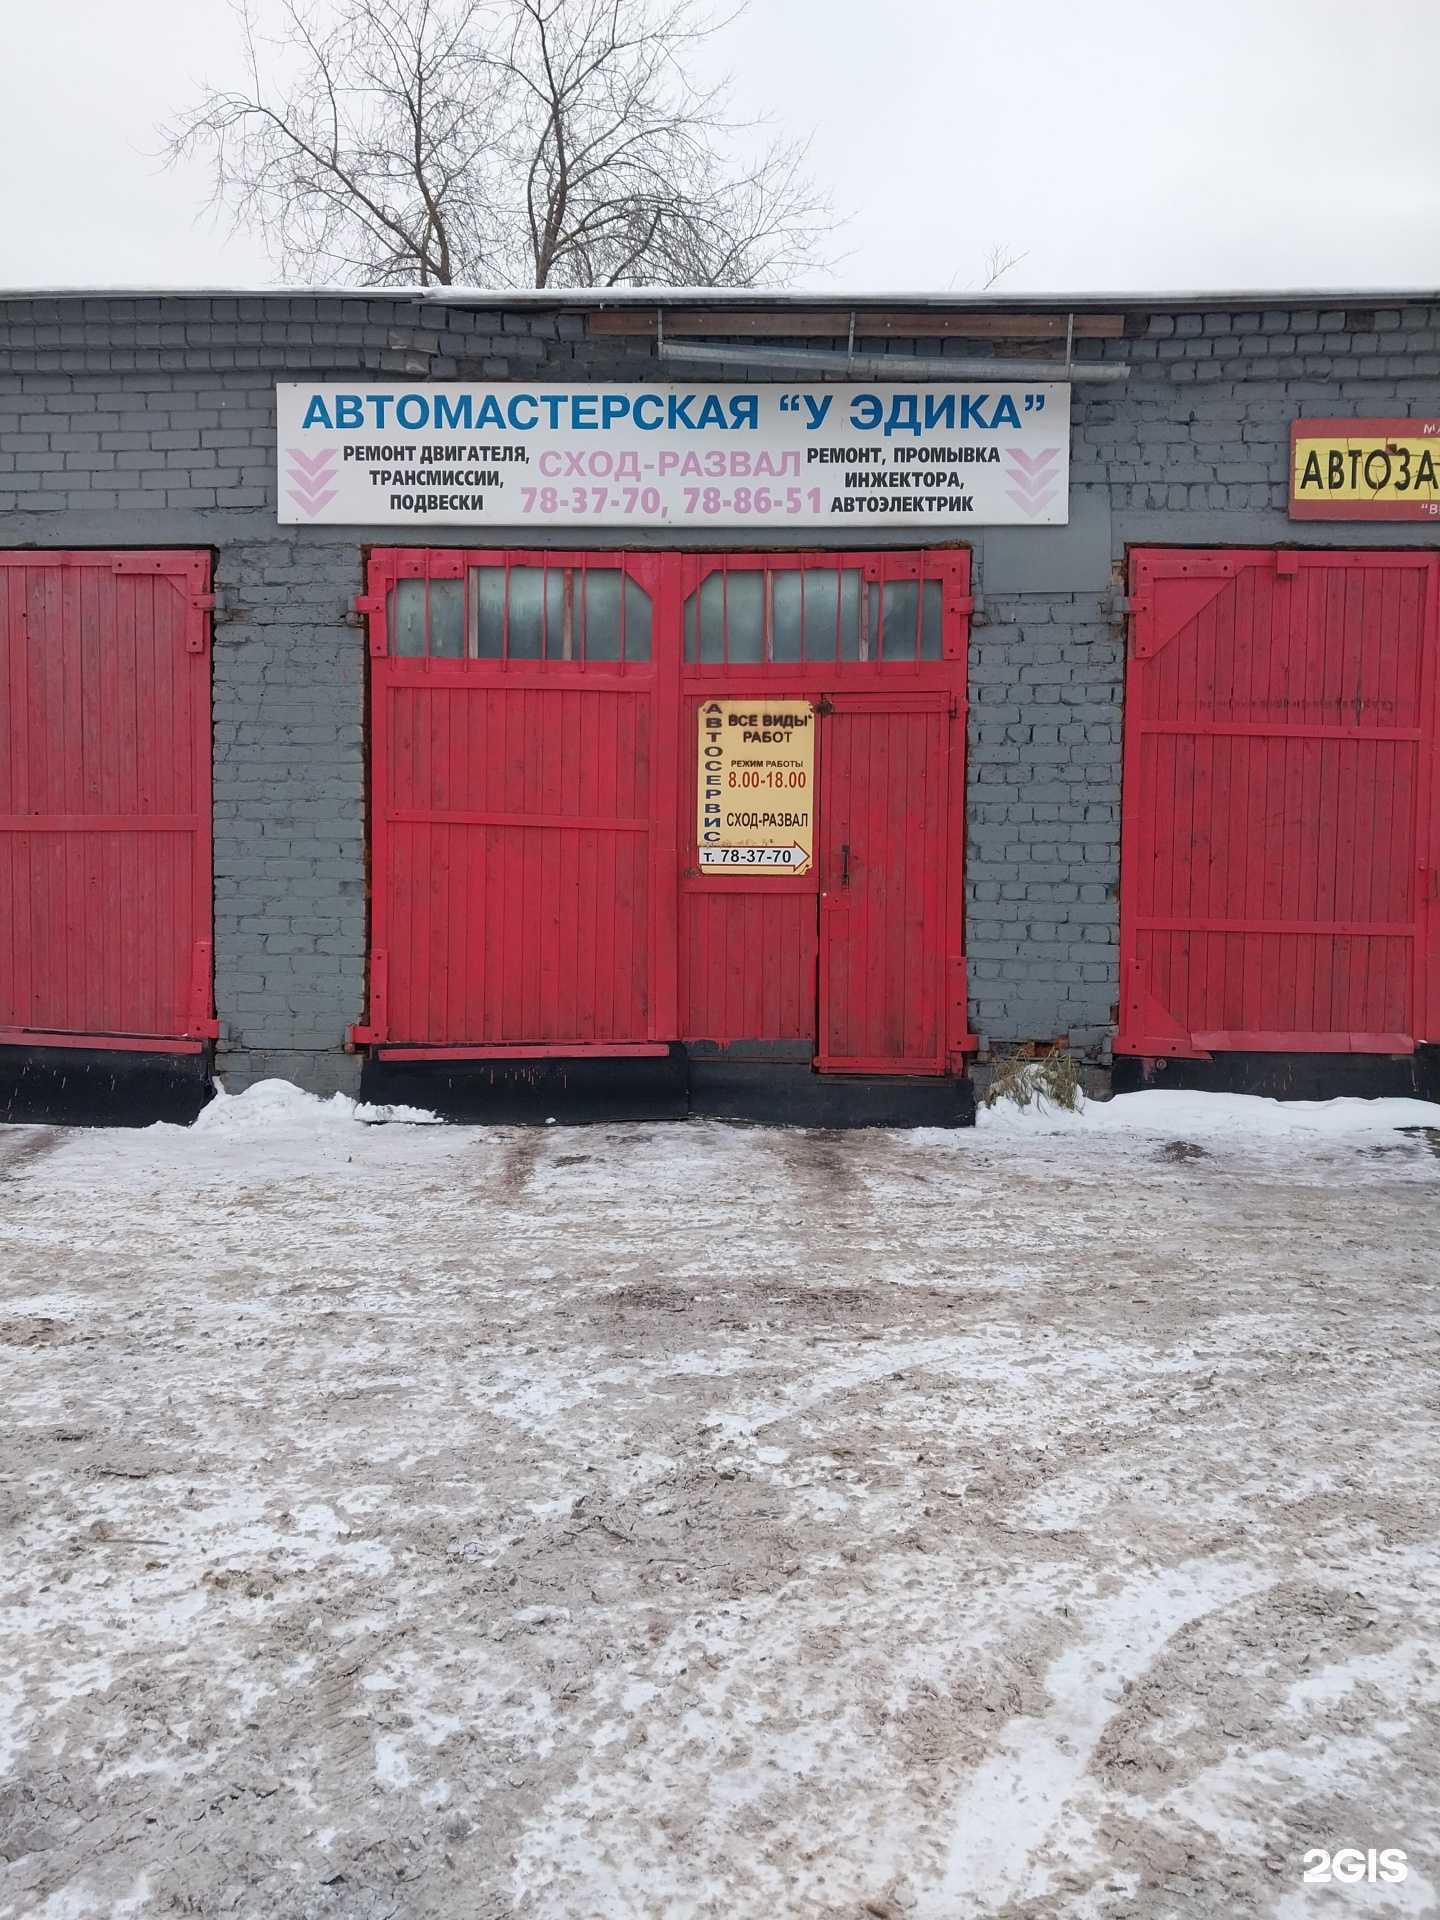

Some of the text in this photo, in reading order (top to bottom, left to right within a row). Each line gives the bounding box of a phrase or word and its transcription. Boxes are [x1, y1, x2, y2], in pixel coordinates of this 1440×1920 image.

[302, 394, 759, 431] АВТОМАСТЕРСКАЯ
[849, 394, 1045, 437] ЭДИКА”
[343, 446, 530, 465] РЕМОНТ ДВИГАТЕЛЯ,
[807, 447, 1001, 466] РЕМОНТ, ПРОМЫВКА
[538, 450, 801, 483] СХОД-РАЗВАЛ
[369, 470, 504, 489] ТРАНСМИССИИ,
[844, 471, 965, 490] ИНЖЕКТОРА,
[390, 494, 483, 514] ПОДВЕСКИ
[520, 487, 821, 518] 78-37-70, 78-86-51
[830, 496, 974, 513] АВТОЭЛЕКТРИК
[728, 715, 808, 729] ВСЕ ВИДЫ
[743, 731, 792, 743] РАБОТ
[703, 703, 723, 842] АВТОСЕРВИС
[731, 760, 803, 768] РЕЖИМ РАБОТЫ
[728, 771, 806, 788] 8.00-18.00
[727, 812, 808, 829] СХОД-РАЗВАЛ
[721, 849, 792, 863] 78-37-70
